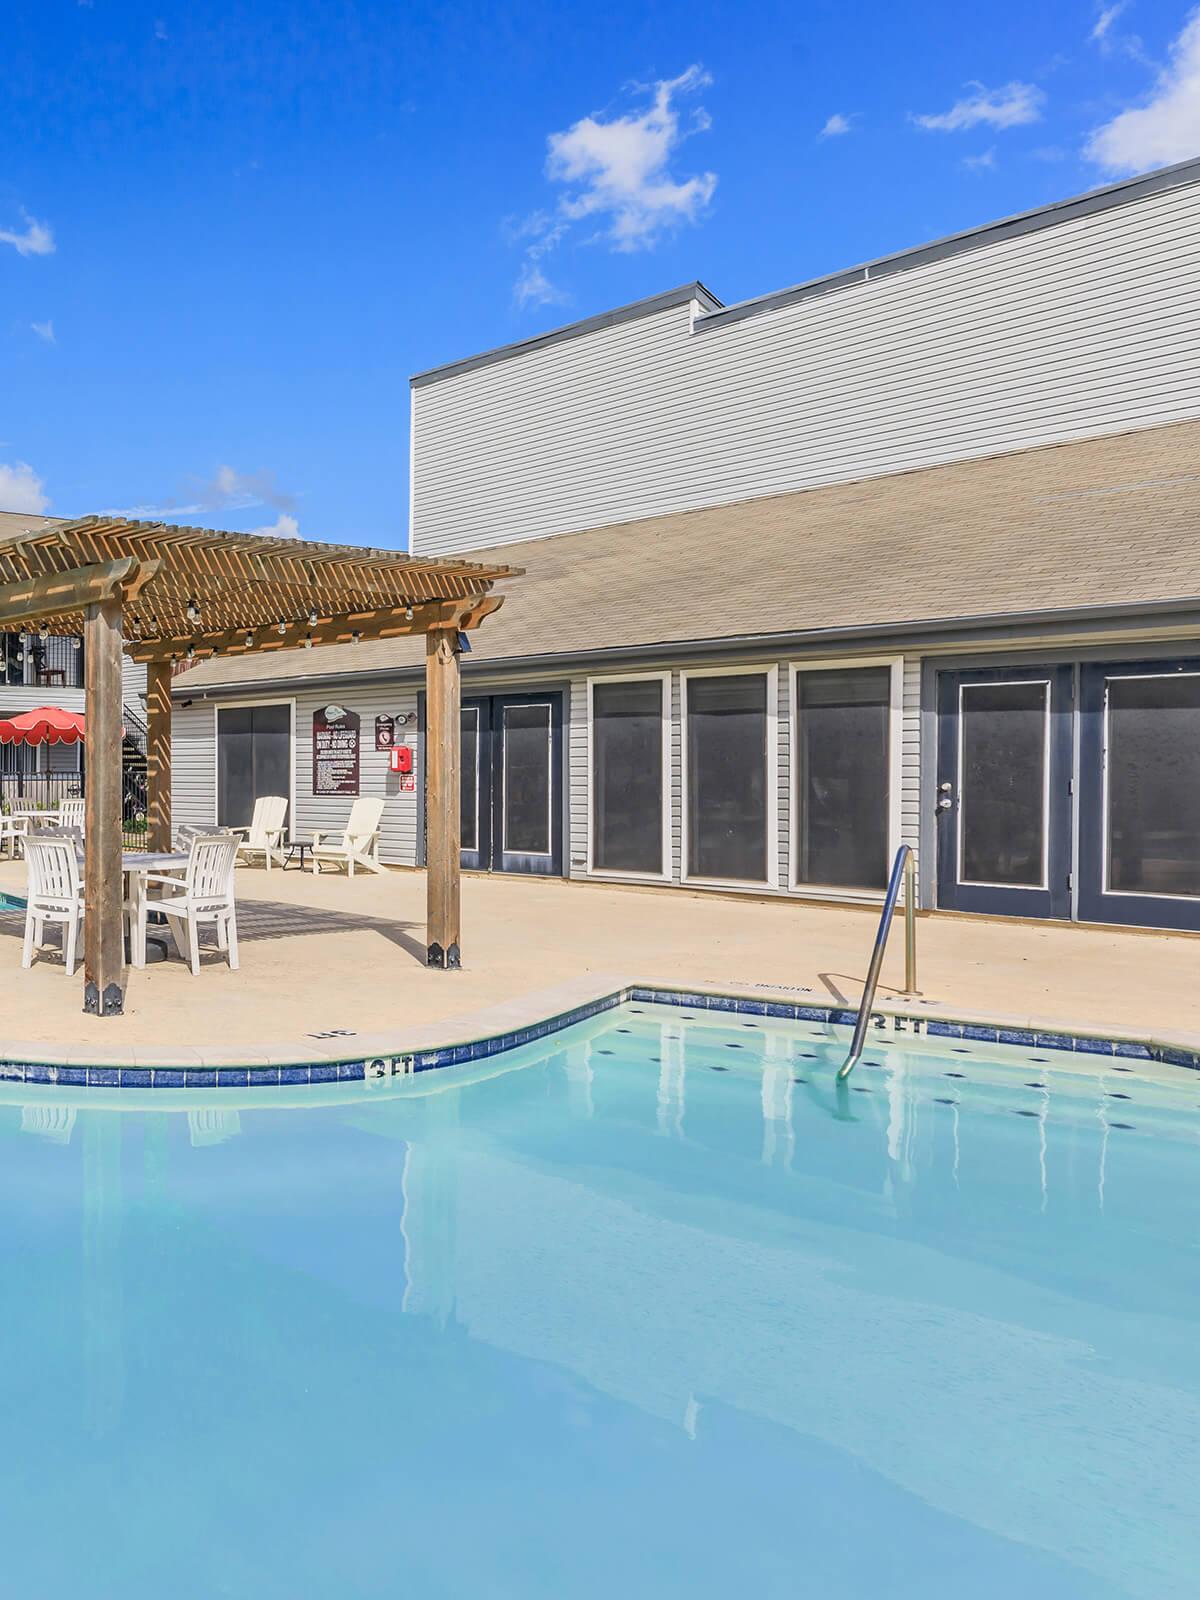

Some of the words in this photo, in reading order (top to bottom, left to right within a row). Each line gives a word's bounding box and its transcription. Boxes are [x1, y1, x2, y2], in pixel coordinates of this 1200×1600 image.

[870, 1013, 886, 1029] 3
[895, 1016, 925, 1033] FT
[370, 1059, 385, 1078] 3
[391, 1056, 412, 1076] FT
